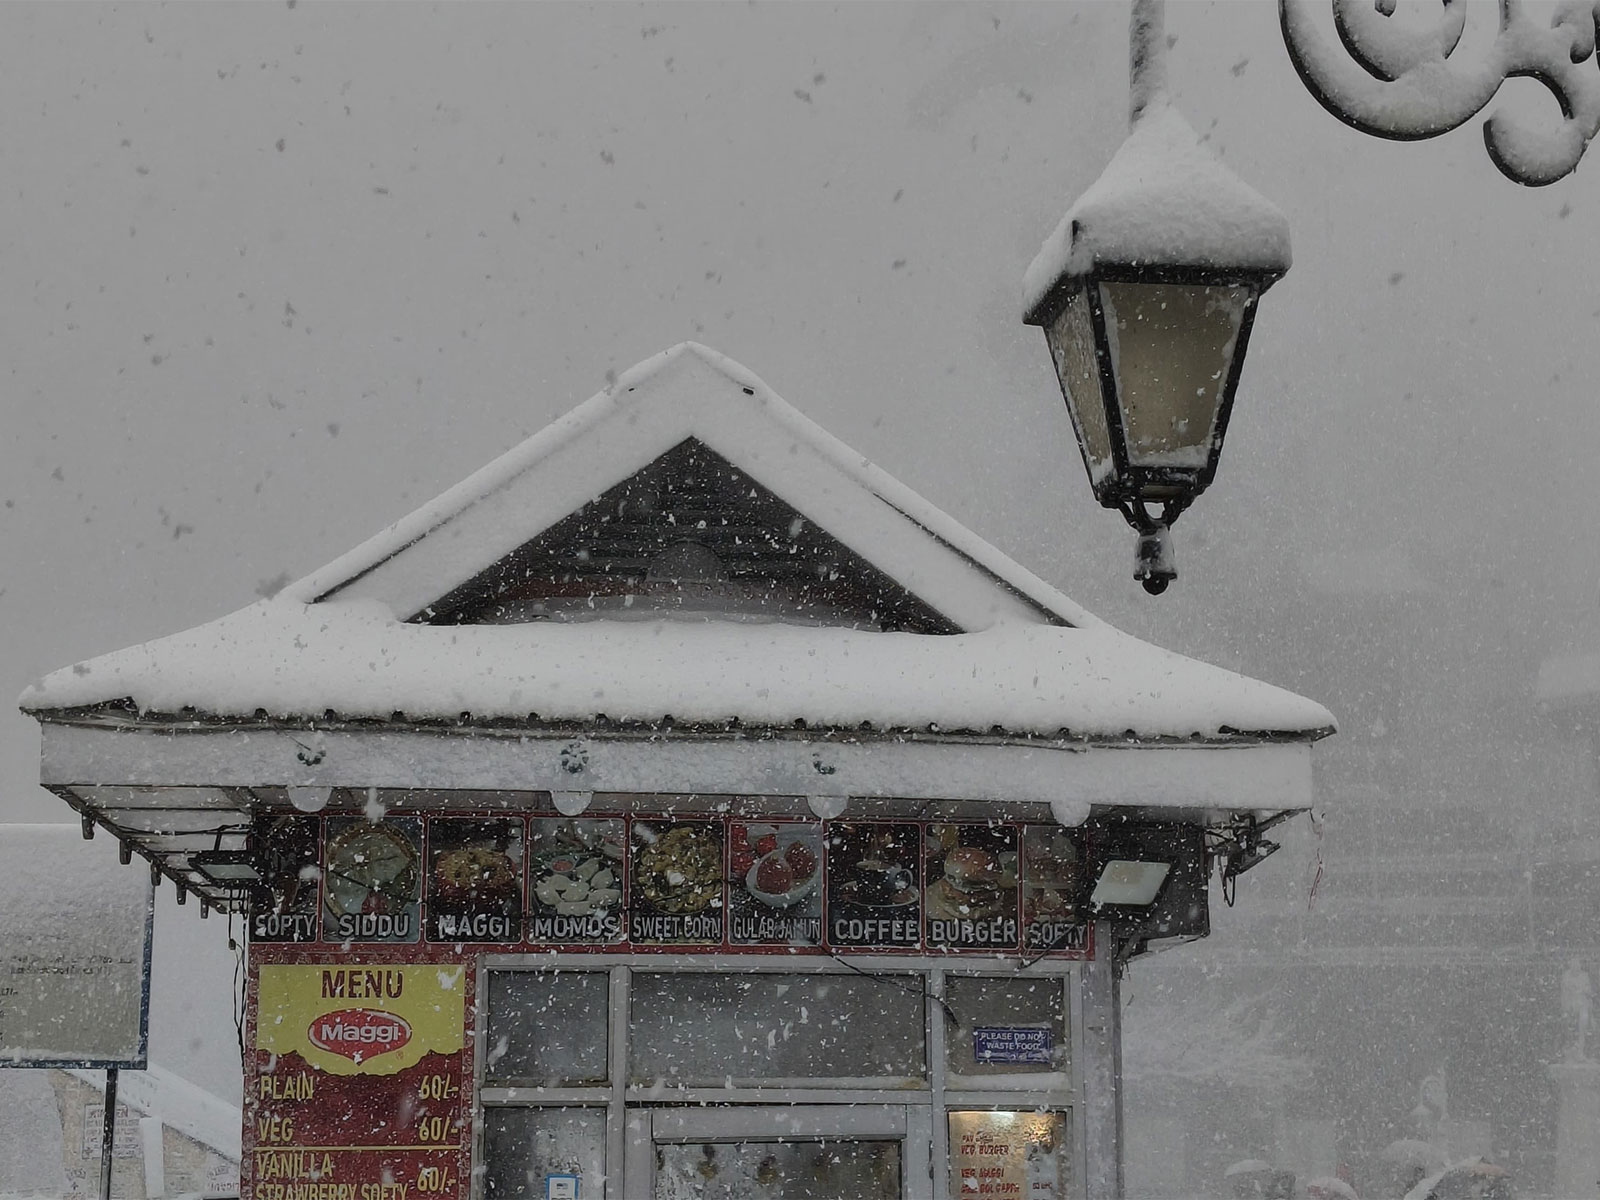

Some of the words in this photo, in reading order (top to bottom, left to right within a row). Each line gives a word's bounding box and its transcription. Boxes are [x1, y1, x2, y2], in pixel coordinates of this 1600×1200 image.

[339, 914, 409, 936] SIDDU
[438, 915, 510, 937] MAGGI
[534, 916, 618, 937] MOMOS
[632, 916, 681, 938] SWEET
[684, 917, 721, 938] CORN
[733, 917, 774, 938] GULAB
[834, 919, 919, 941] COFFEE
[931, 920, 1017, 943] BURGER
[1029, 922, 1087, 945] SOFTY
[321, 970, 403, 999] MENU
[321, 1023, 399, 1043] Maggi
[981, 1032, 1012, 1040] PLEASE
[1014, 1033, 1026, 1041] DO
[986, 1042, 1014, 1050] WASTE
[1016, 1042, 1040, 1050] FOOD
[260, 1075, 314, 1100] PLAIN
[420, 1075, 459, 1100] 60/-
[258, 1117, 294, 1142] VEG
[419, 1116, 458, 1142] 60/-
[979, 1144, 1009, 1155] BURGER
[256, 1153, 333, 1178] VANILLA
[417, 1166, 457, 1192] 60/-
[255, 1183, 358, 1200] STRAWBERRY
[361, 1183, 408, 1200] SOFTY
